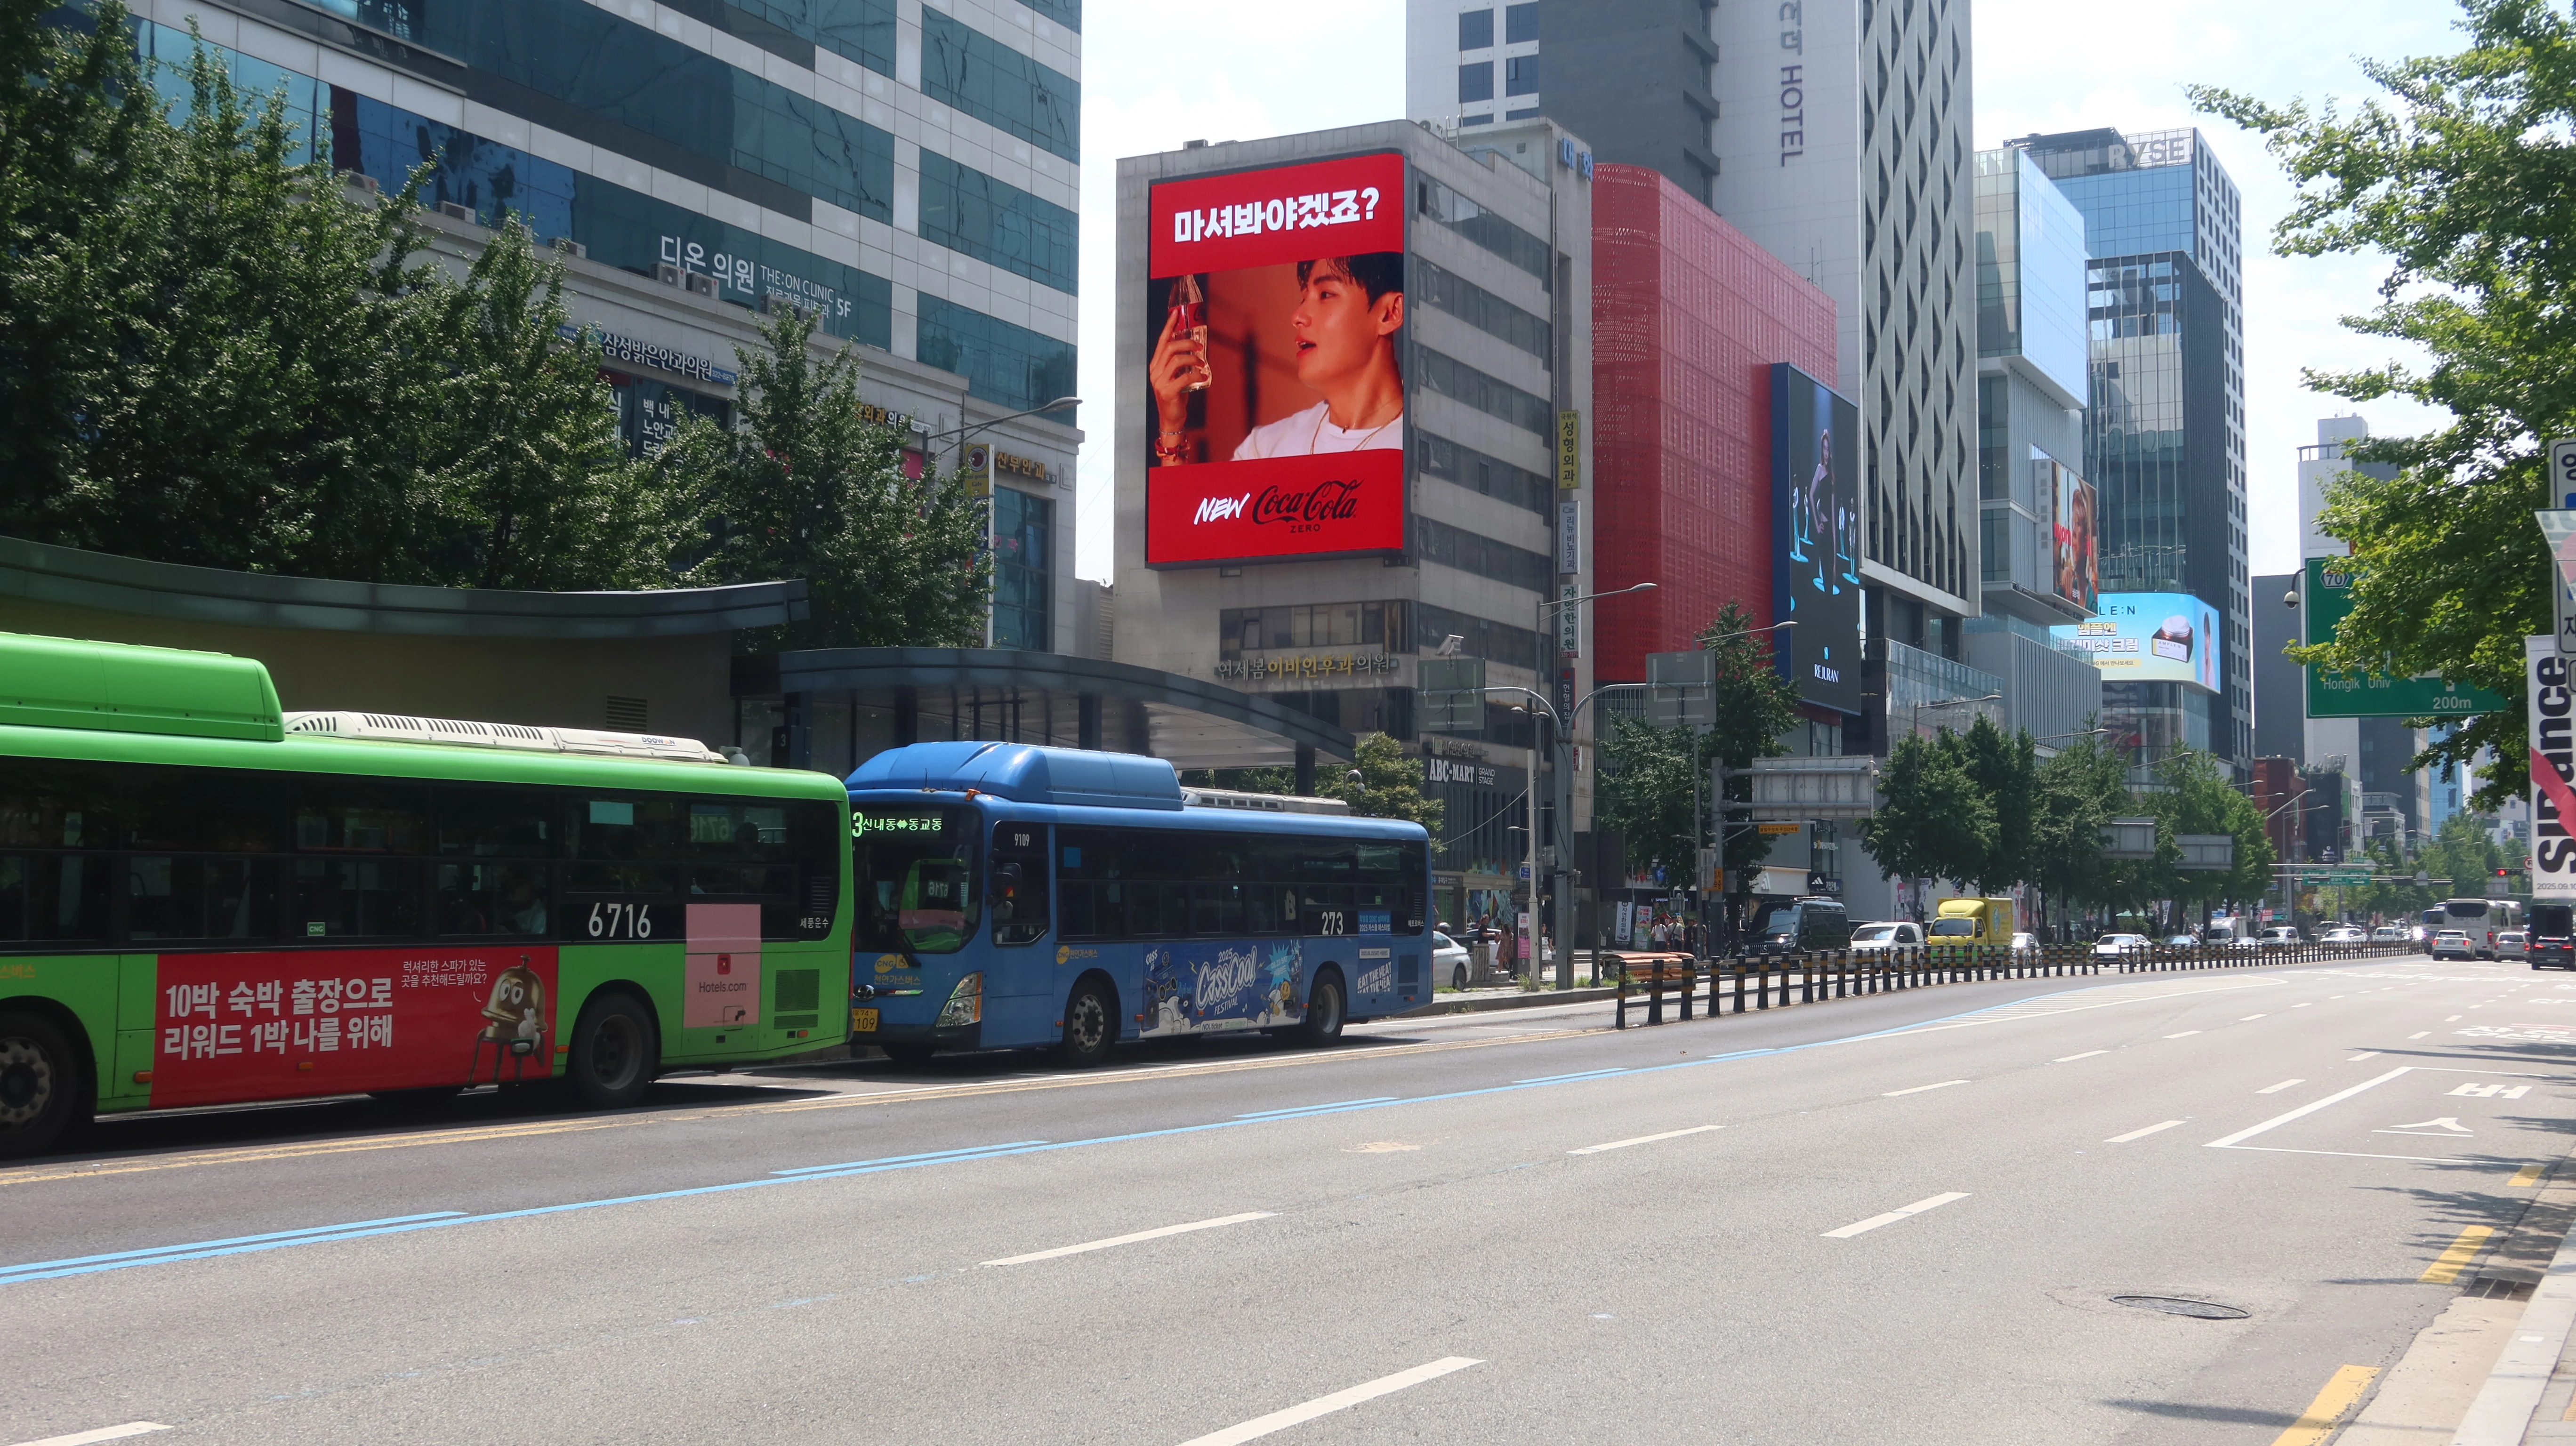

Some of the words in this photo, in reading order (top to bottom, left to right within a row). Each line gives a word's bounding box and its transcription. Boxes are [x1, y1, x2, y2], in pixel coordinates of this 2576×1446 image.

[1781, 65, 1803, 167] HOTEL
[2108, 137, 2185, 169] RYSE
[1175, 186, 1380, 242] 마셔봐야겠죠?
[661, 235, 706, 273] 디온
[712, 254, 754, 295] 의원
[760, 265, 800, 292] THE:ON
[803, 280, 835, 304] CLINIC
[837, 297, 852, 318] 5F
[603, 332, 712, 383] 삼성밝은안과의원
[1562, 421, 1575, 482] 성형외과
[997, 451, 1046, 480] 산부인과
[1193, 492, 1250, 525] NEW
[1252, 478, 1365, 525] Coca-Cola
[1290, 524, 1321, 534] ZERO
[1566, 515, 1575, 569] 리뉴비뇨기과
[2326, 574, 2343, 586] 70
[1563, 586, 1577, 650] 자연한의원
[2112, 638, 2139, 652] 크림
[1814, 664, 1838, 683] REJURAN
[2323, 678, 2360, 692] Hongik
[1562, 683, 1570, 720] 헌혈의집
[2432, 696, 2471, 709] 200m
[781, 733, 786, 747] 3
[1429, 758, 1475, 783] ABC-MART
[1478, 767, 1495, 777] GRAND
[1478, 777, 1494, 786] STAGE
[863, 818, 896, 831] 신내동
[909, 818, 942, 831] 동교동
[1014, 833, 1030, 847] 9109
[588, 902, 651, 938] 6716
[800, 917, 829, 929] 세풍운수
[1321, 911, 1344, 935] 273
[1359, 924, 1368, 932] 2025
[1218, 948, 1233, 964] 2025
[402, 959, 439, 974] 럭셔리한
[441, 959, 467, 972] 스파가
[469, 959, 486, 972] 있는
[401, 974, 419, 988] 곳을
[421, 973, 487, 987] 추천해드릴까요?
[699, 981, 747, 993] Hotels.com
[874, 975, 921, 985] 천연가스버스
[166, 981, 220, 1020] 10박
[228, 980, 283, 1018] 숙박
[291, 977, 393, 1015] 출장으로
[1214, 996, 1239, 1016] FESTIVAL
[164, 1023, 243, 1060] 리워드
[250, 1019, 290, 1055] 1박
[293, 1017, 342, 1052] 나를
[346, 1014, 393, 1049] 위해
